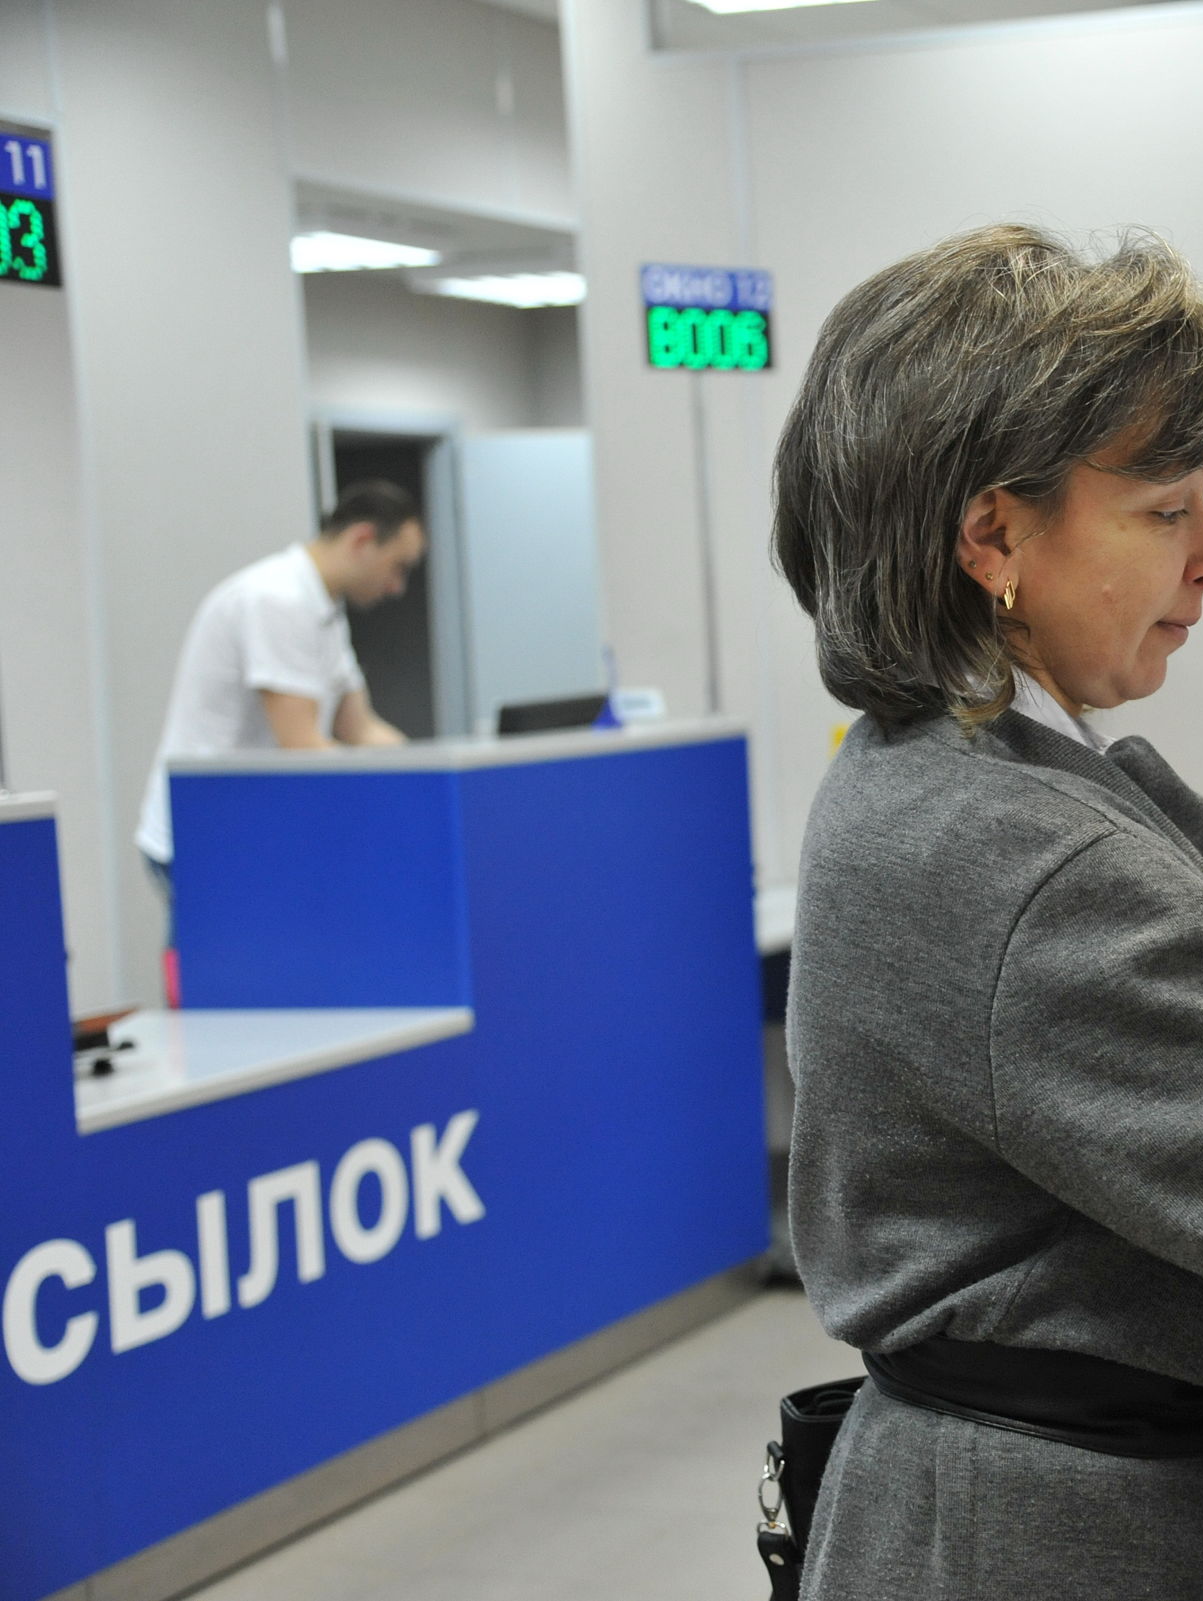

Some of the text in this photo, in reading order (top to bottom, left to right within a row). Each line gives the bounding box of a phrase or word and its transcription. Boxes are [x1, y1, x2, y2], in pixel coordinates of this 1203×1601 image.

[4, 140, 47, 190] 11
[0, 199, 47, 281] 3
[3, 1109, 487, 1385] СЫЛОК
